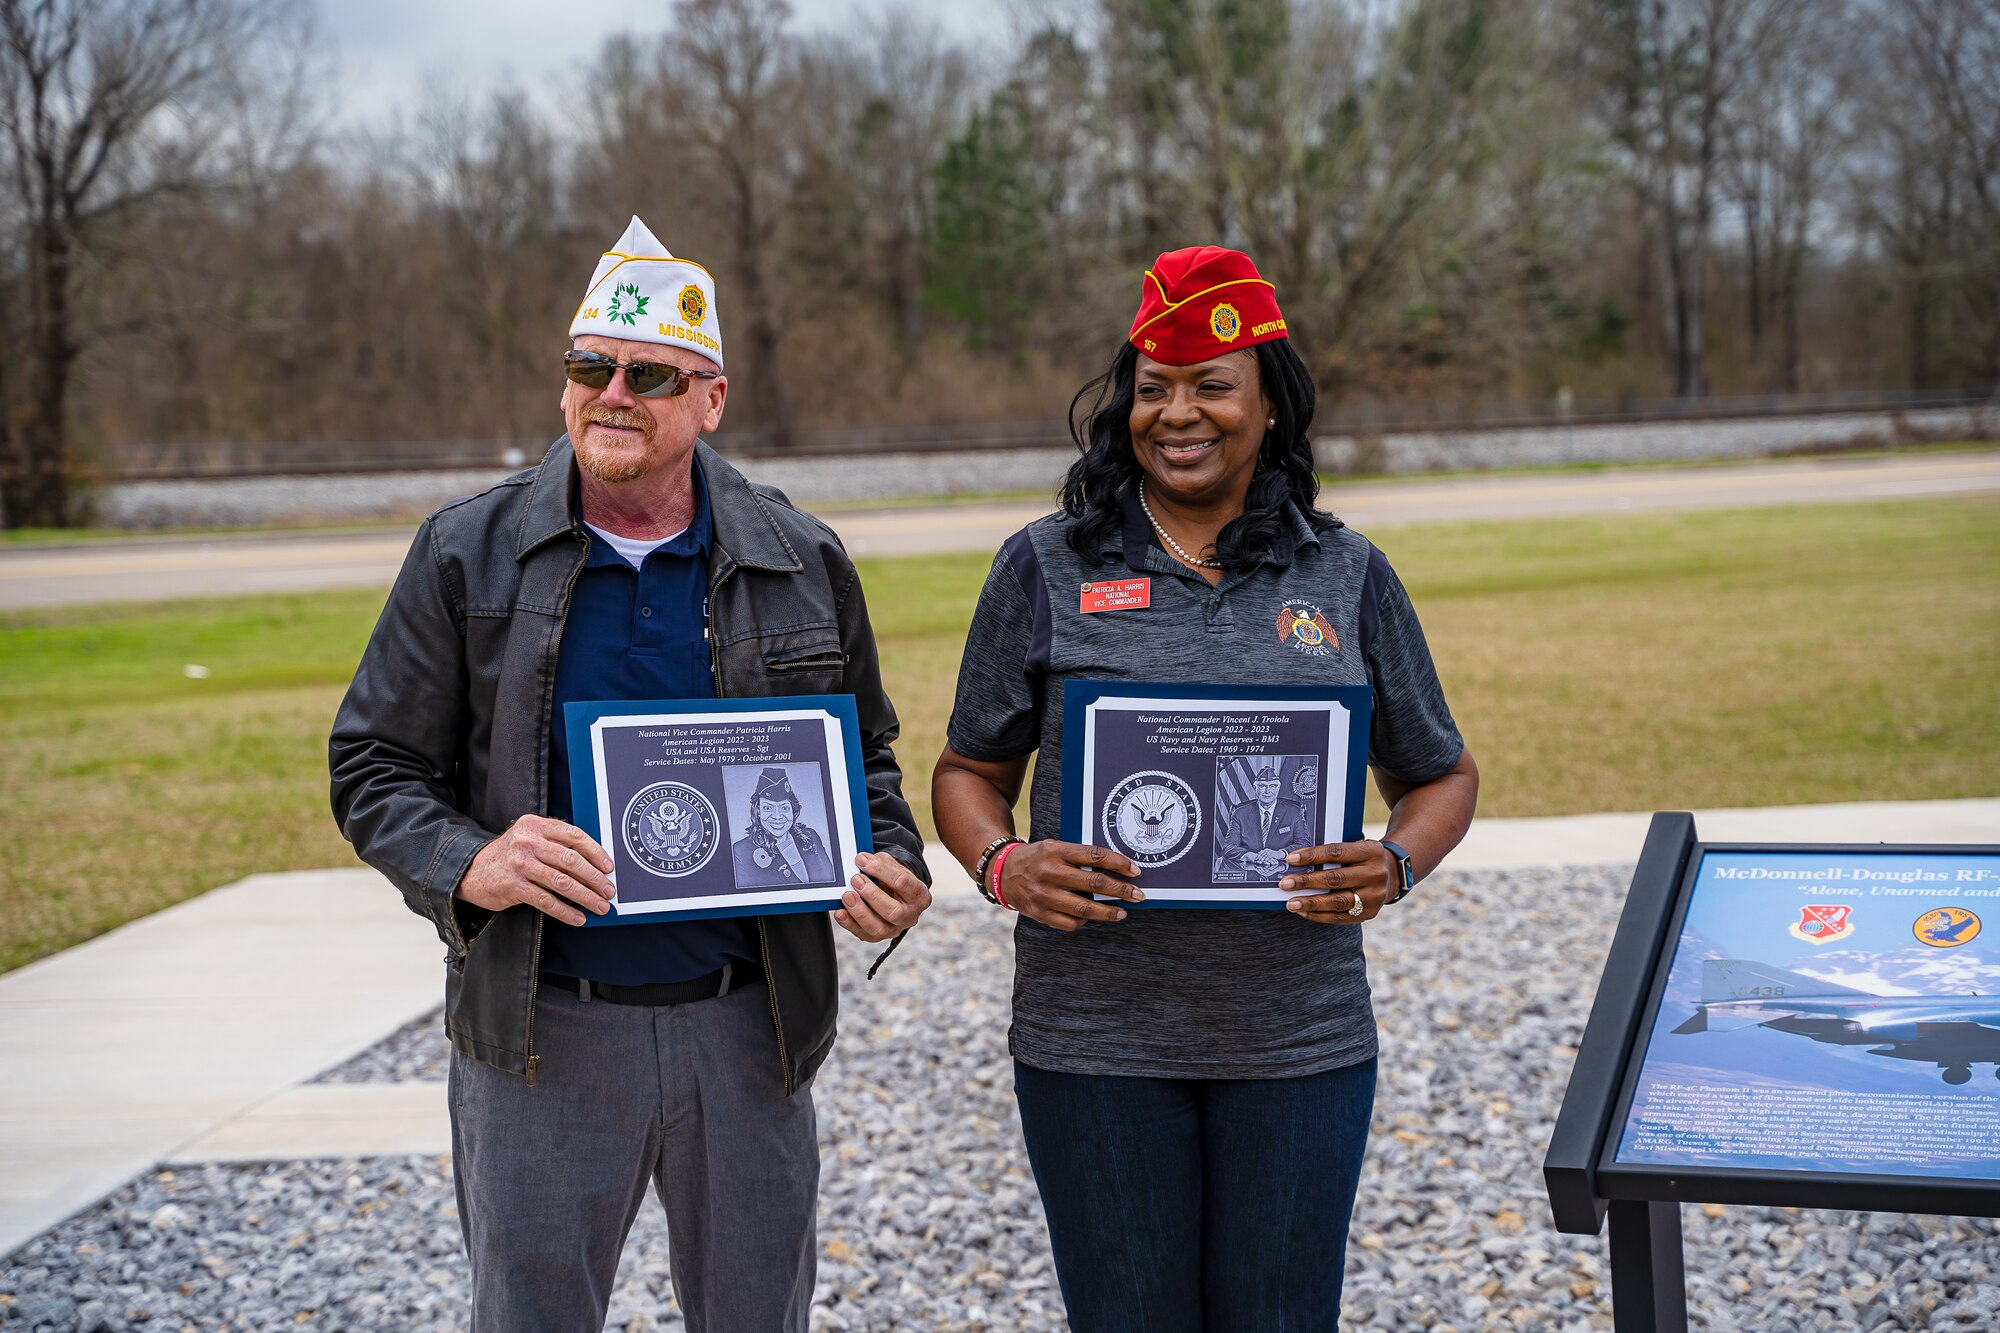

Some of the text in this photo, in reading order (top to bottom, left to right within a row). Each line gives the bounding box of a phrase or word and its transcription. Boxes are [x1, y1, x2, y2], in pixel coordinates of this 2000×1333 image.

[582, 307, 599, 320] 134
[1252, 321, 1277, 337] NORTH
[659, 323, 720, 355] MISSISSIPPI
[1144, 339, 1157, 352] 157
[1092, 585, 1114, 594] PATRICIA
[1125, 582, 1144, 590] HARRIS
[1109, 597, 1142, 606] COMMANDER
[1282, 600, 1322, 612] AMERICAN
[638, 729, 670, 737] National
[690, 727, 734, 736] Commander
[1195, 726, 1222, 735] Legion
[700, 738, 725, 746] Legion
[1159, 736, 1179, 745] Navy
[1198, 736, 1218, 745] Navy
[757, 745, 769, 753] Sgt
[700, 756, 716, 765] May
[633, 789, 706, 816] UNITED STATES
[1108, 779, 1196, 829] UNITED STATES
[1133, 851, 1169, 862] NAVY
[658, 857, 693, 869] ARMY
[1713, 867, 2000, 883] McDonnell-Douglas RF-
[1870, 886, 1961, 896] Unarmed
[1963, 886, 2000, 897] and
[1750, 986, 1785, 996] 438
[1892, 1100, 1954, 1108] radar(SLAR)
[1935, 1129, 1989, 1138] Mississippi
[1655, 1145, 1706, 1154] Mississippi
[1875, 1154, 1931, 1162] Mississippi.
